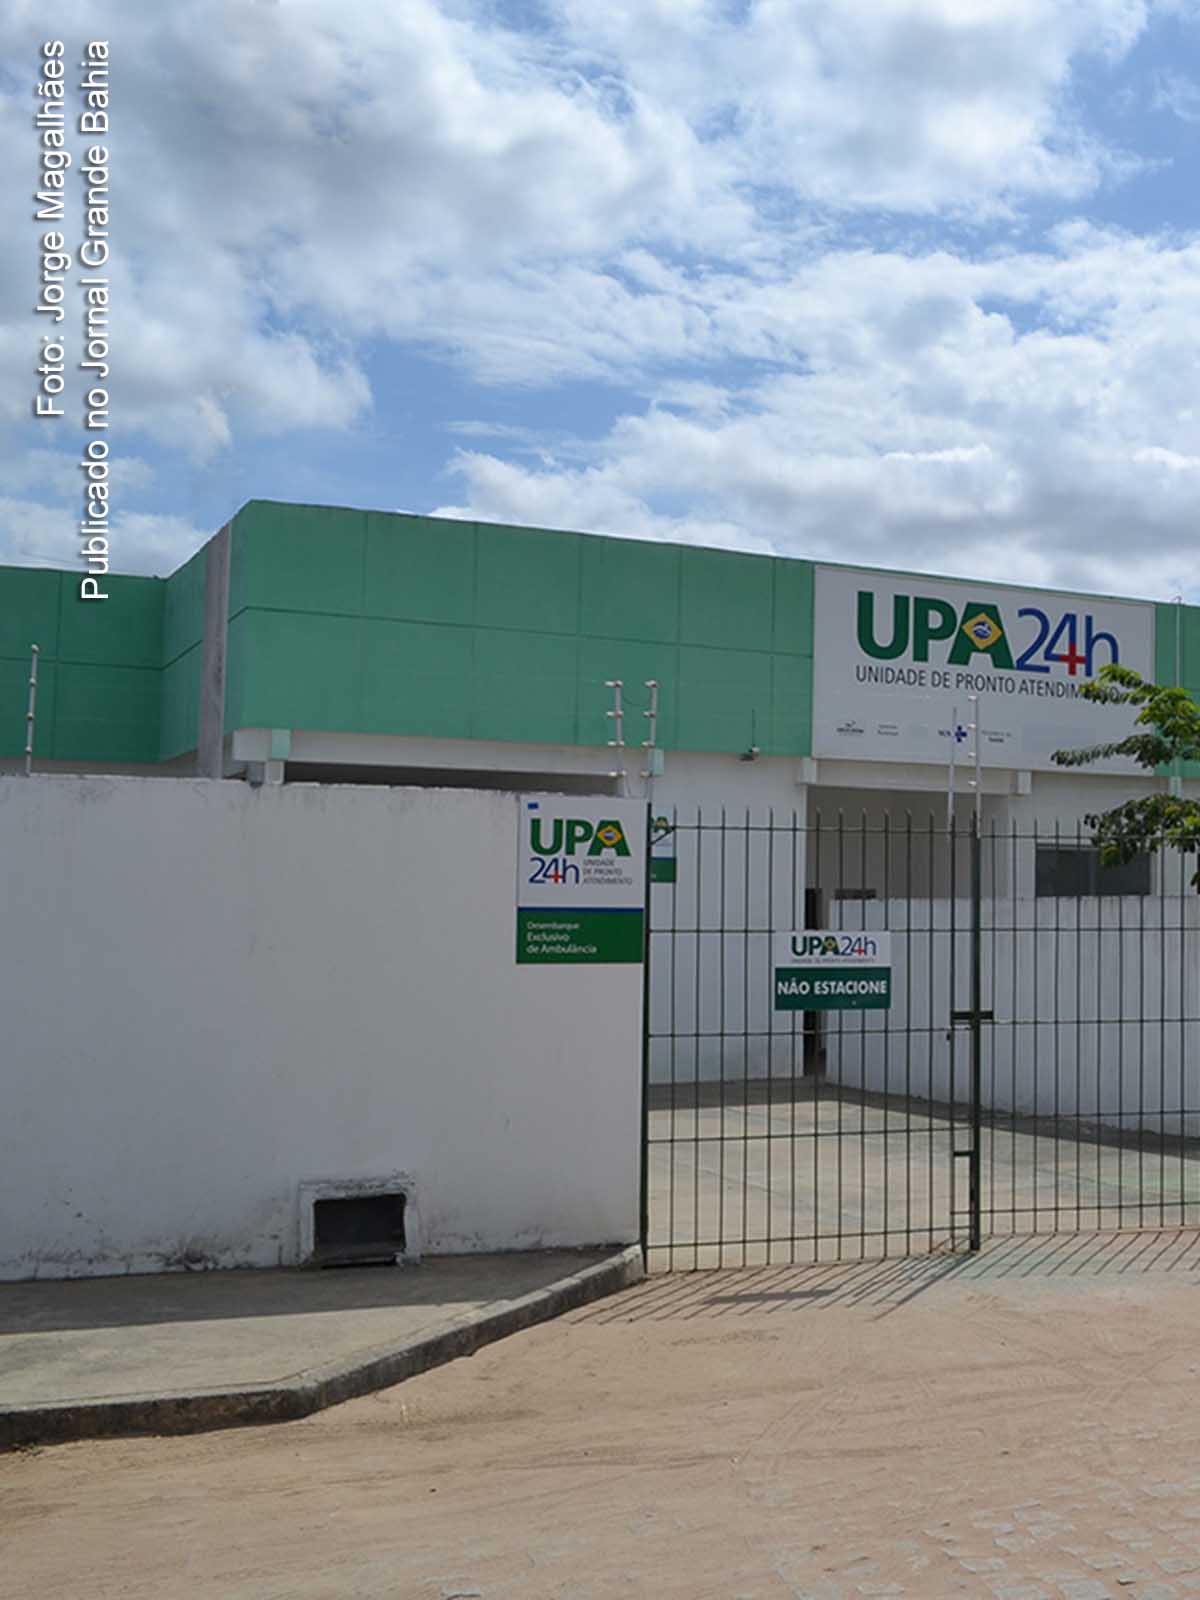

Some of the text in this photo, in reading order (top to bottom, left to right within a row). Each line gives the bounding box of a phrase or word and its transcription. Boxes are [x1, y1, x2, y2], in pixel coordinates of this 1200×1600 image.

[856, 665, 927, 687] UNIDADE
[931, 671, 951, 689] DE
[956, 673, 1016, 694] PRONTO
[530, 818, 631, 857] UPA
[529, 857, 580, 884] 24h
[527, 931, 570, 942] Exclusivo
[526, 944, 597, 954] de Ambulância
[777, 977, 888, 995] NÃO ESTACIONE
